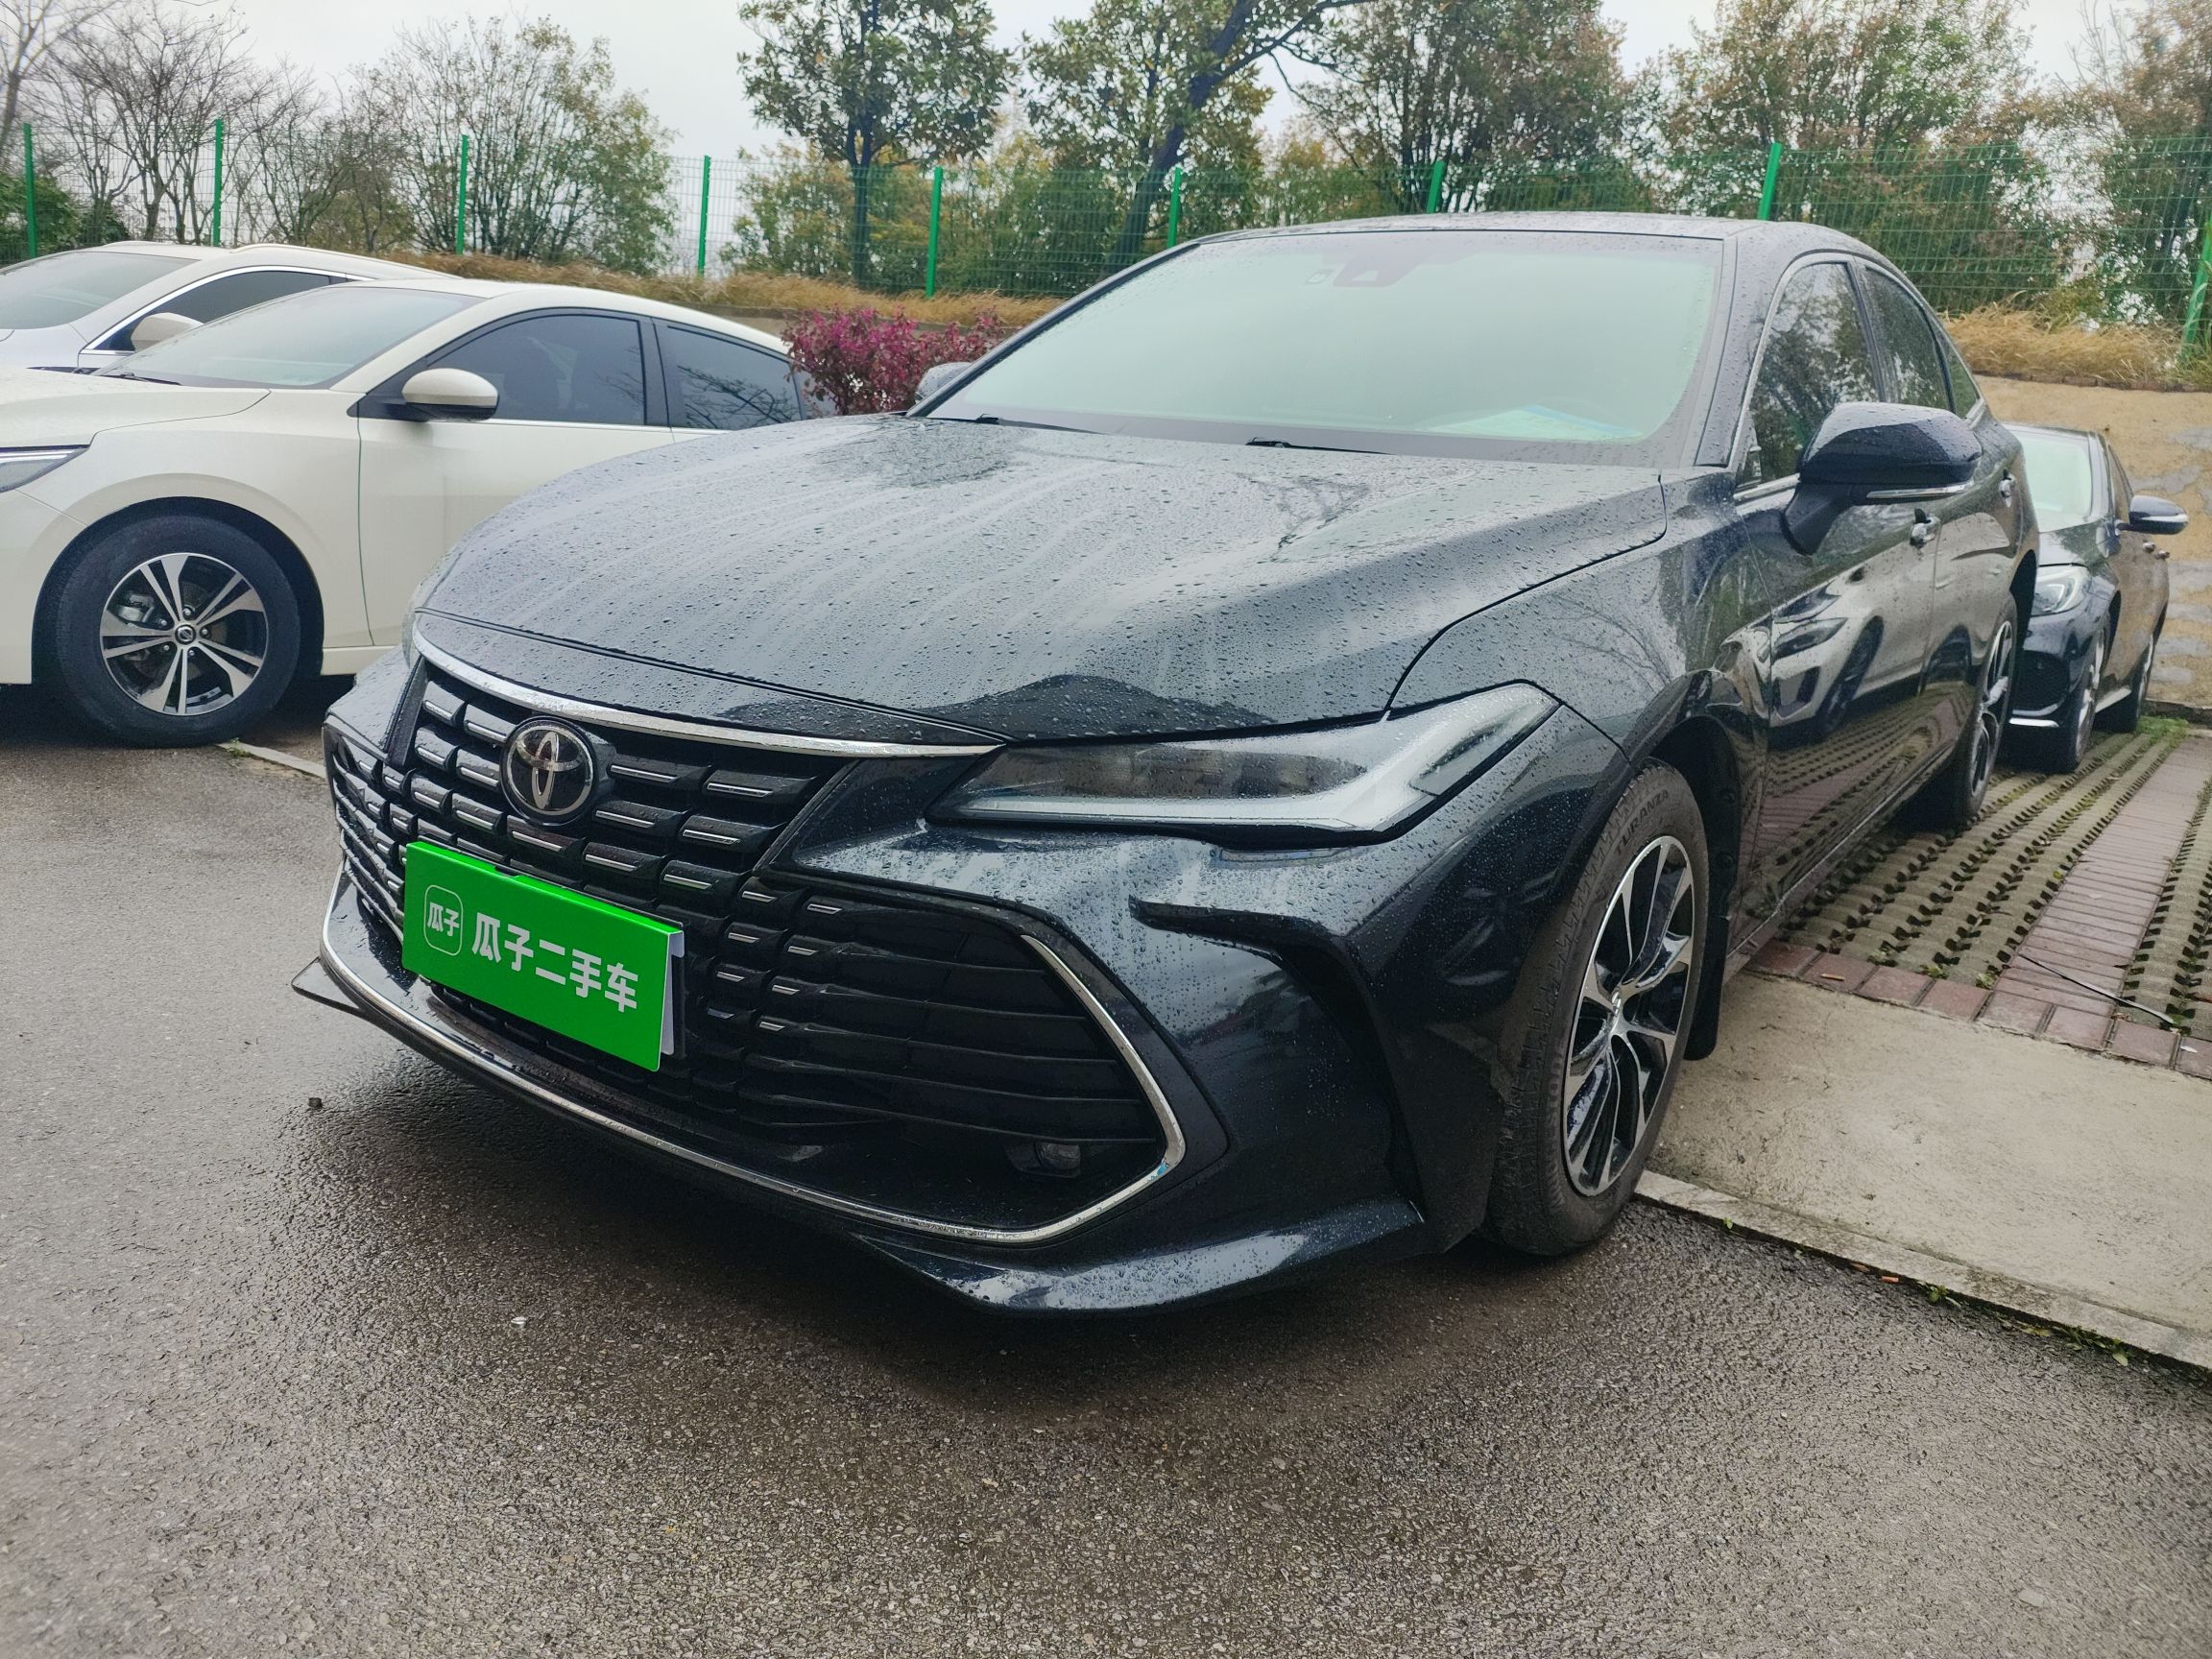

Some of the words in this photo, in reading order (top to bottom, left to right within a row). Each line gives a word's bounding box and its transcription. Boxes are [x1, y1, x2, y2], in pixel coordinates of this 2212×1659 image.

[1614, 789, 1670, 856] TURANZA
[427, 902, 460, 937] 瓜子
[472, 912, 638, 1013] 瓜子二手车
